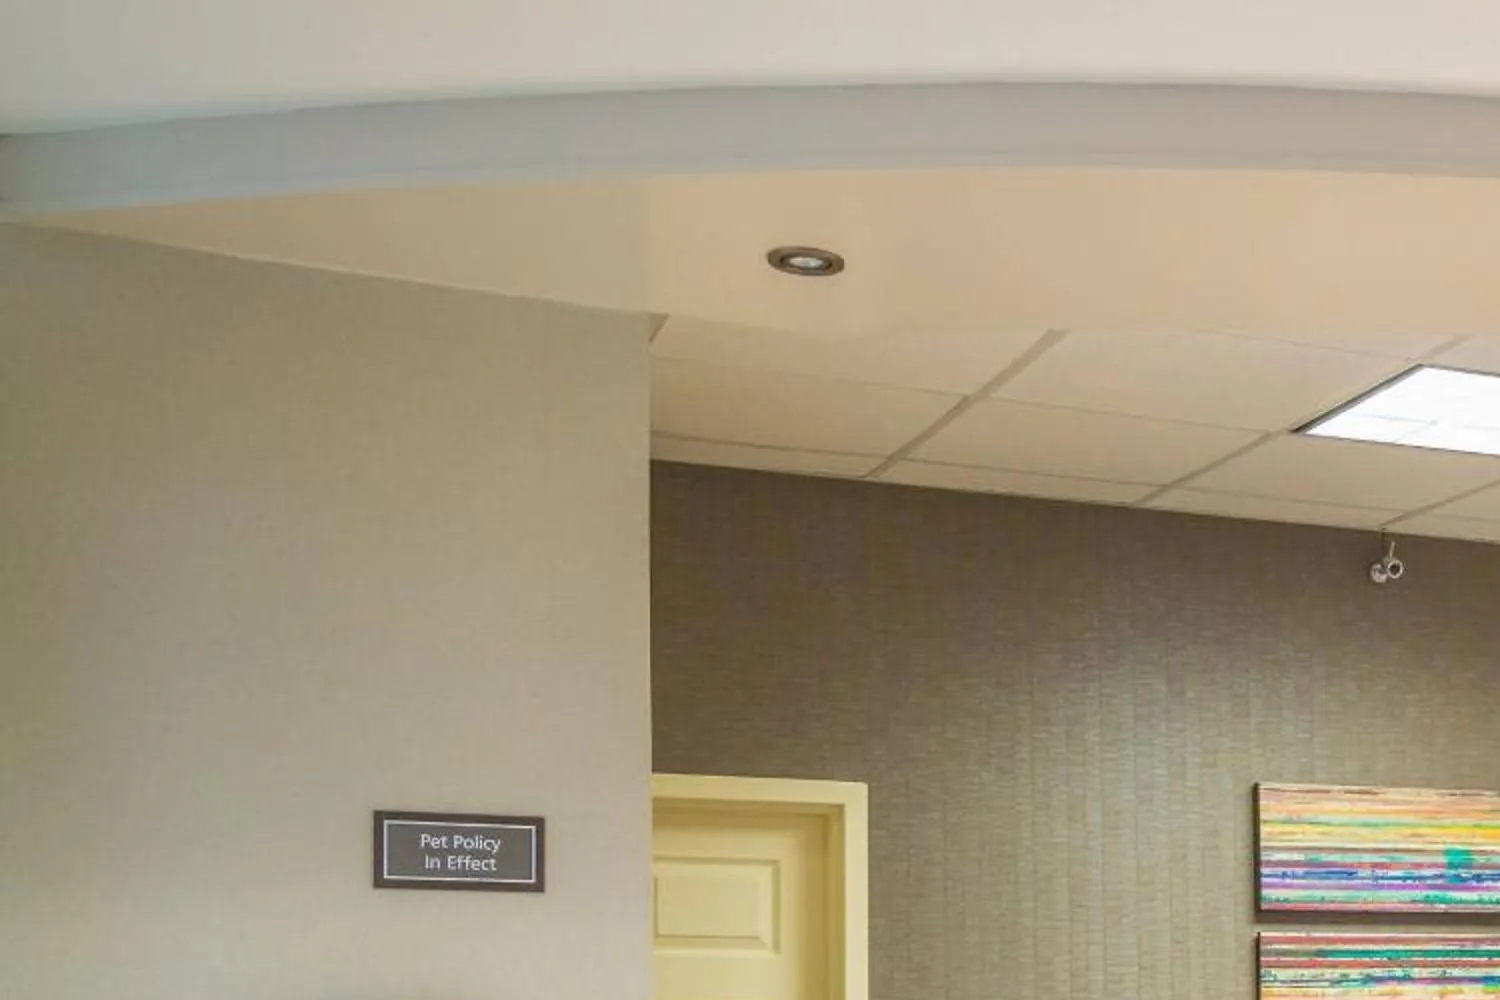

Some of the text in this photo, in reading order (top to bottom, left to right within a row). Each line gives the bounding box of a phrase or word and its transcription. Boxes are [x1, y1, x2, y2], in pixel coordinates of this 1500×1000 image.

[420, 833, 501, 853] Pet Policy
[424, 853, 497, 871] In Effect
